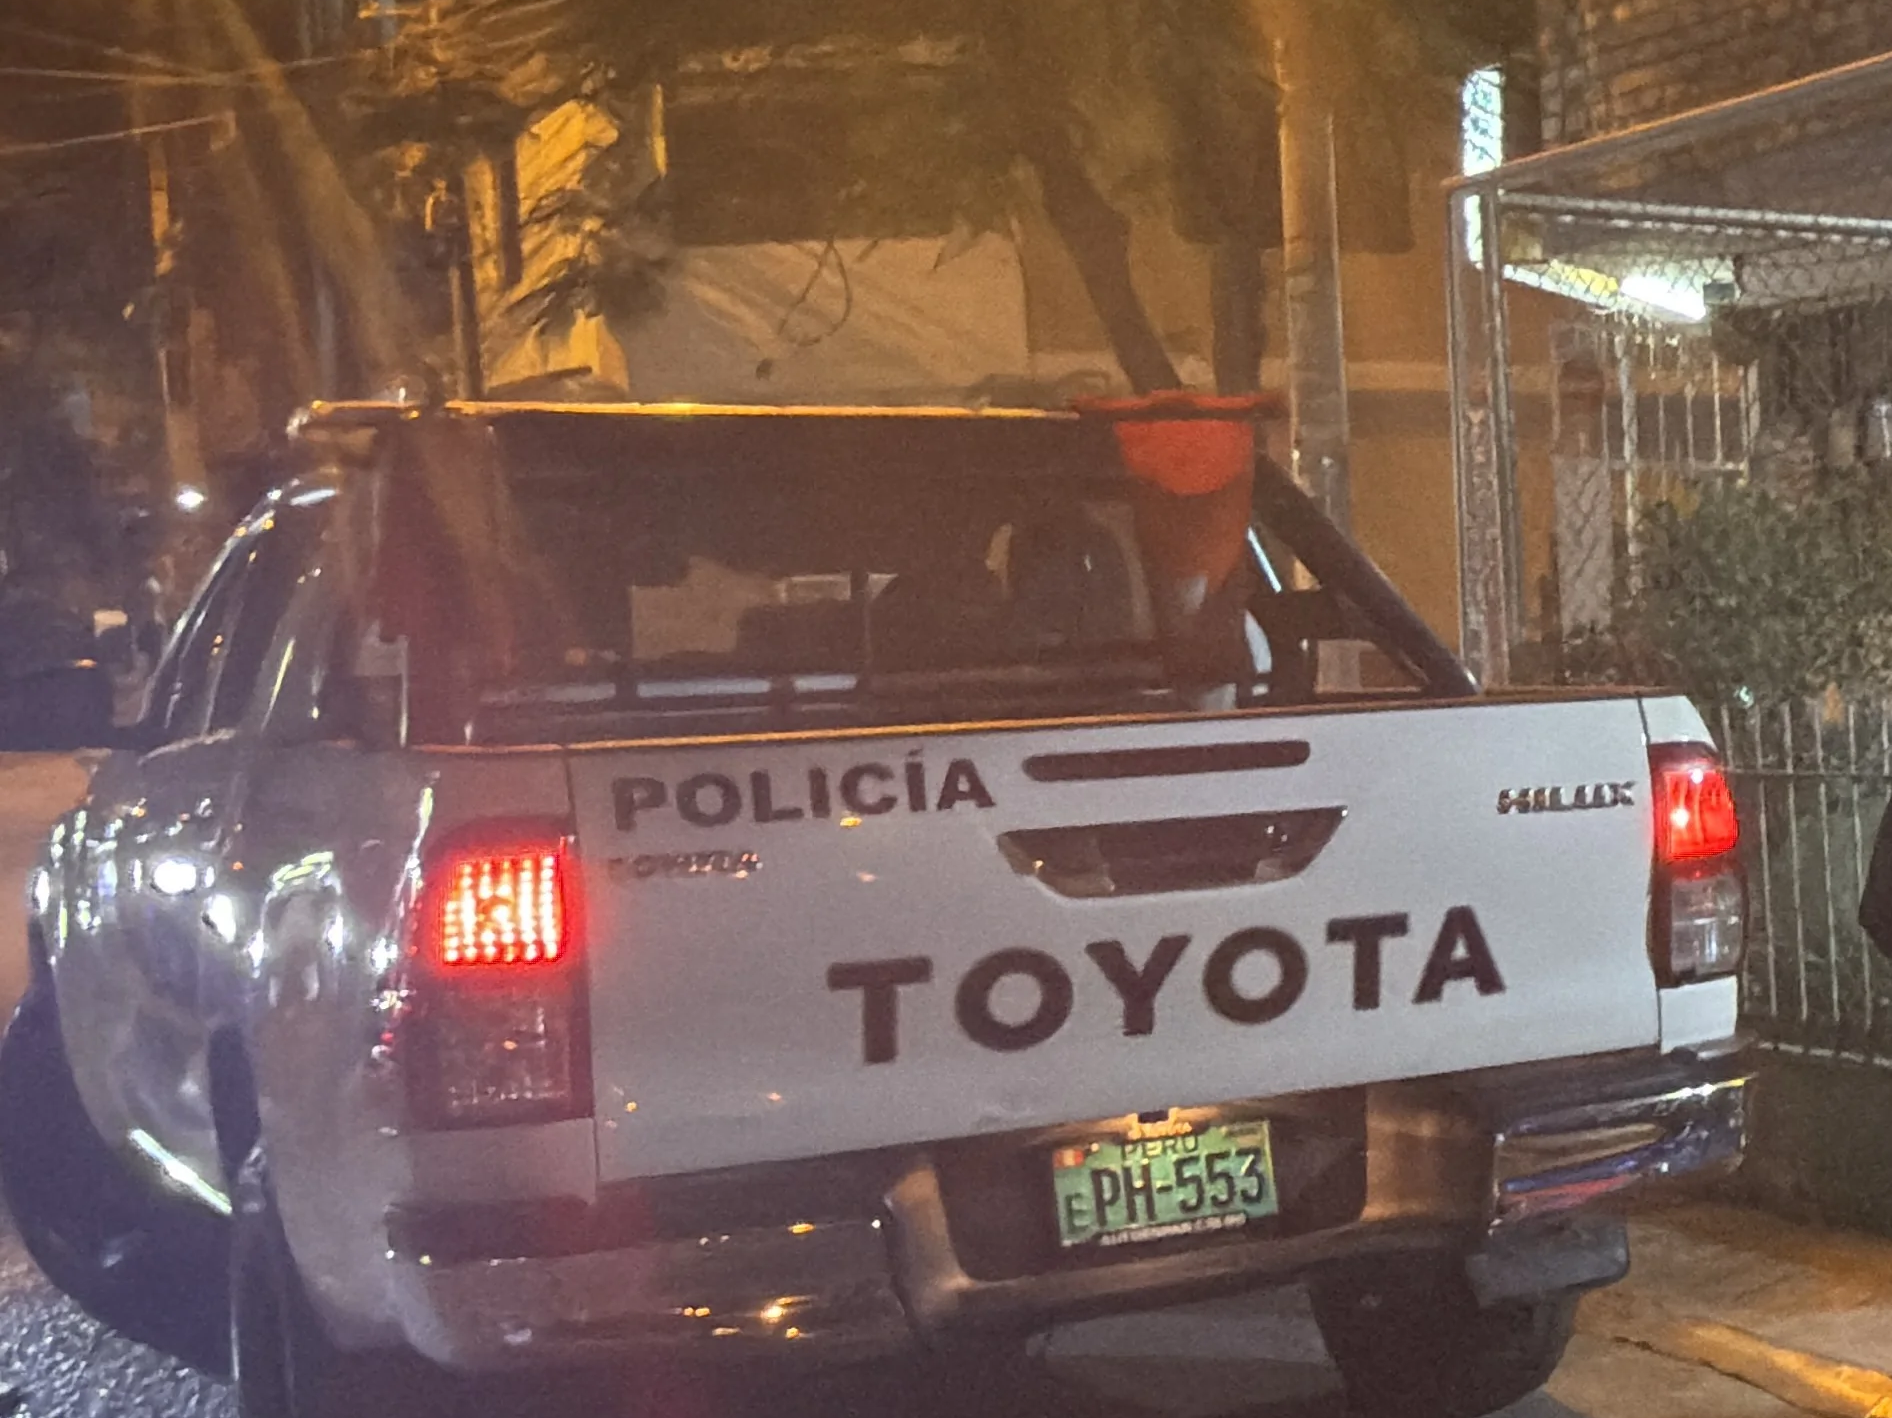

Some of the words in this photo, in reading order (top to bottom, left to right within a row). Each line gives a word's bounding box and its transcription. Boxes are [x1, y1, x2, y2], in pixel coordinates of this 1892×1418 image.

[611, 748, 996, 831] POLICÍA
[1496, 780, 1637, 815] HILUX
[825, 904, 1506, 1065] TOYOTA
